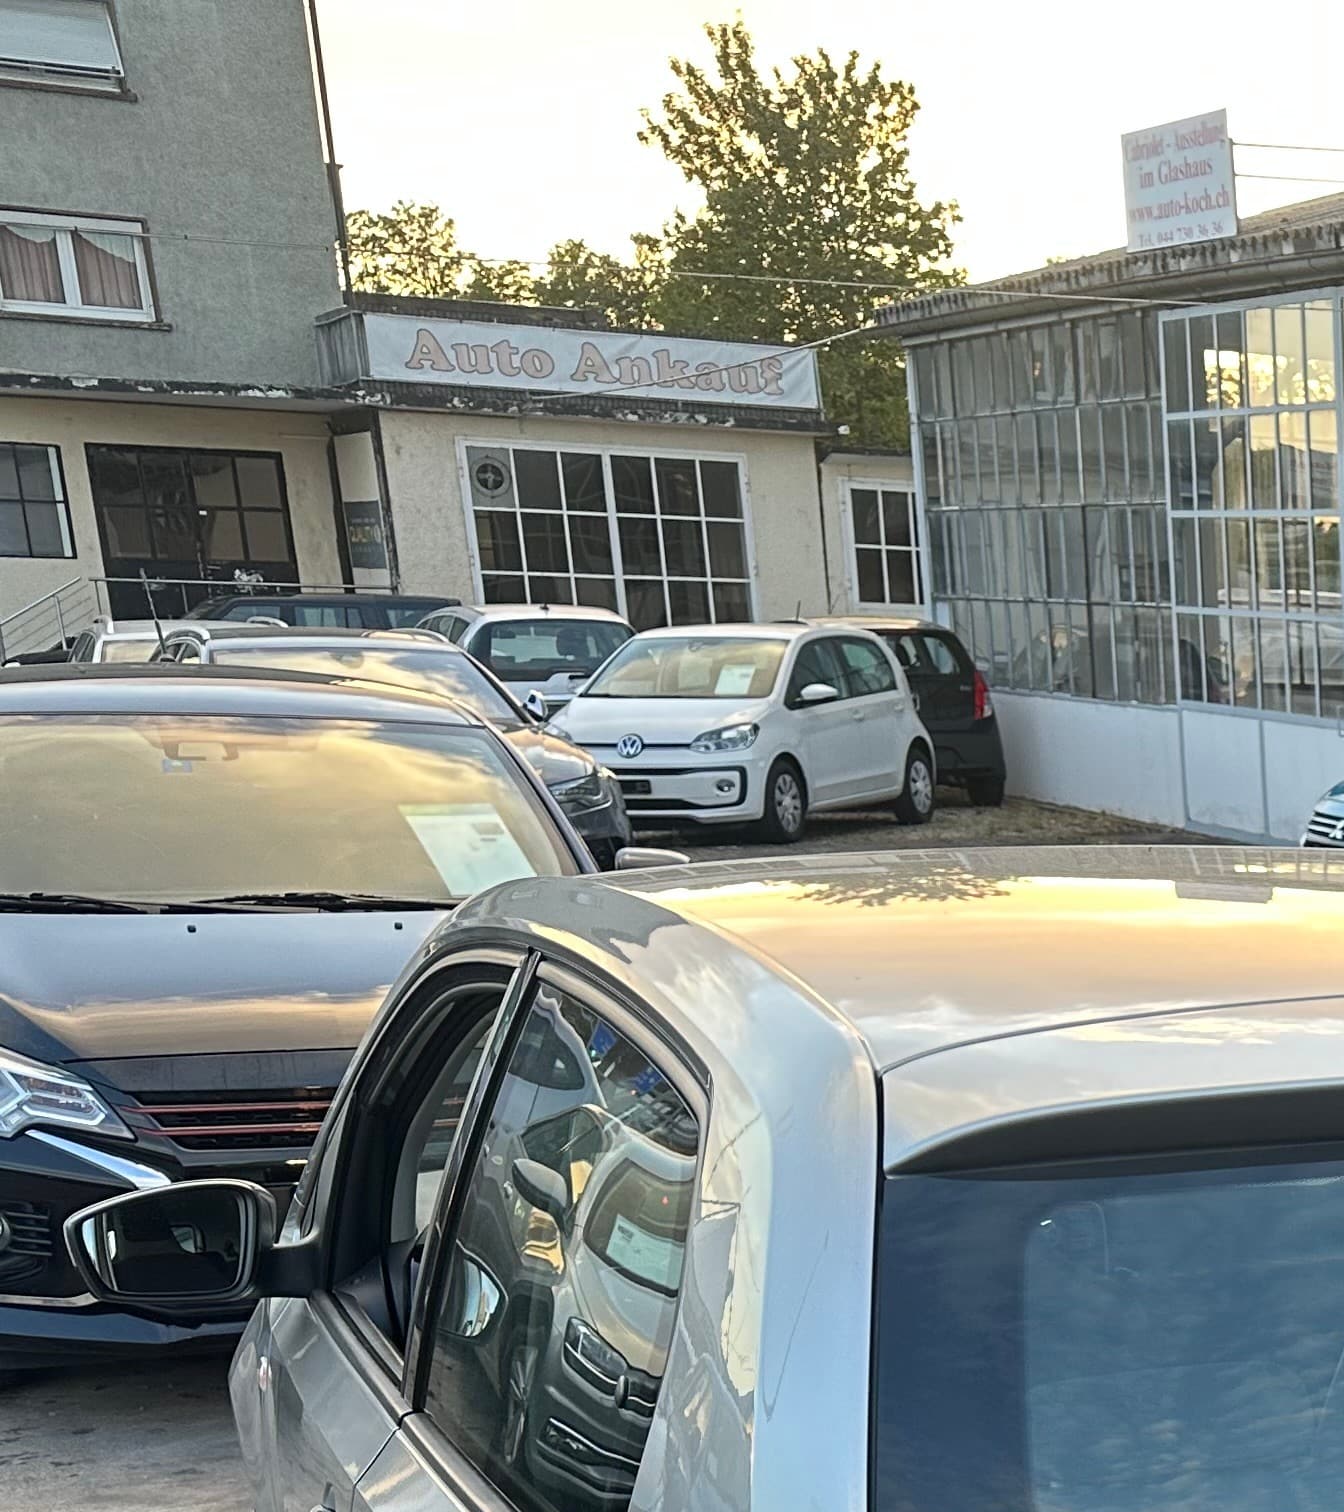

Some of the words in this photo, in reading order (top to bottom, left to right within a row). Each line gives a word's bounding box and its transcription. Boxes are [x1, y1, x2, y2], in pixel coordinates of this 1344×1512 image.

[1138, 165, 1155, 189] im
[1158, 155, 1214, 185] Glashaus
[1128, 183, 1230, 222] www.auto-koch.ch
[404, 328, 555, 379] Auto
[570, 341, 785, 396] Ankauf
